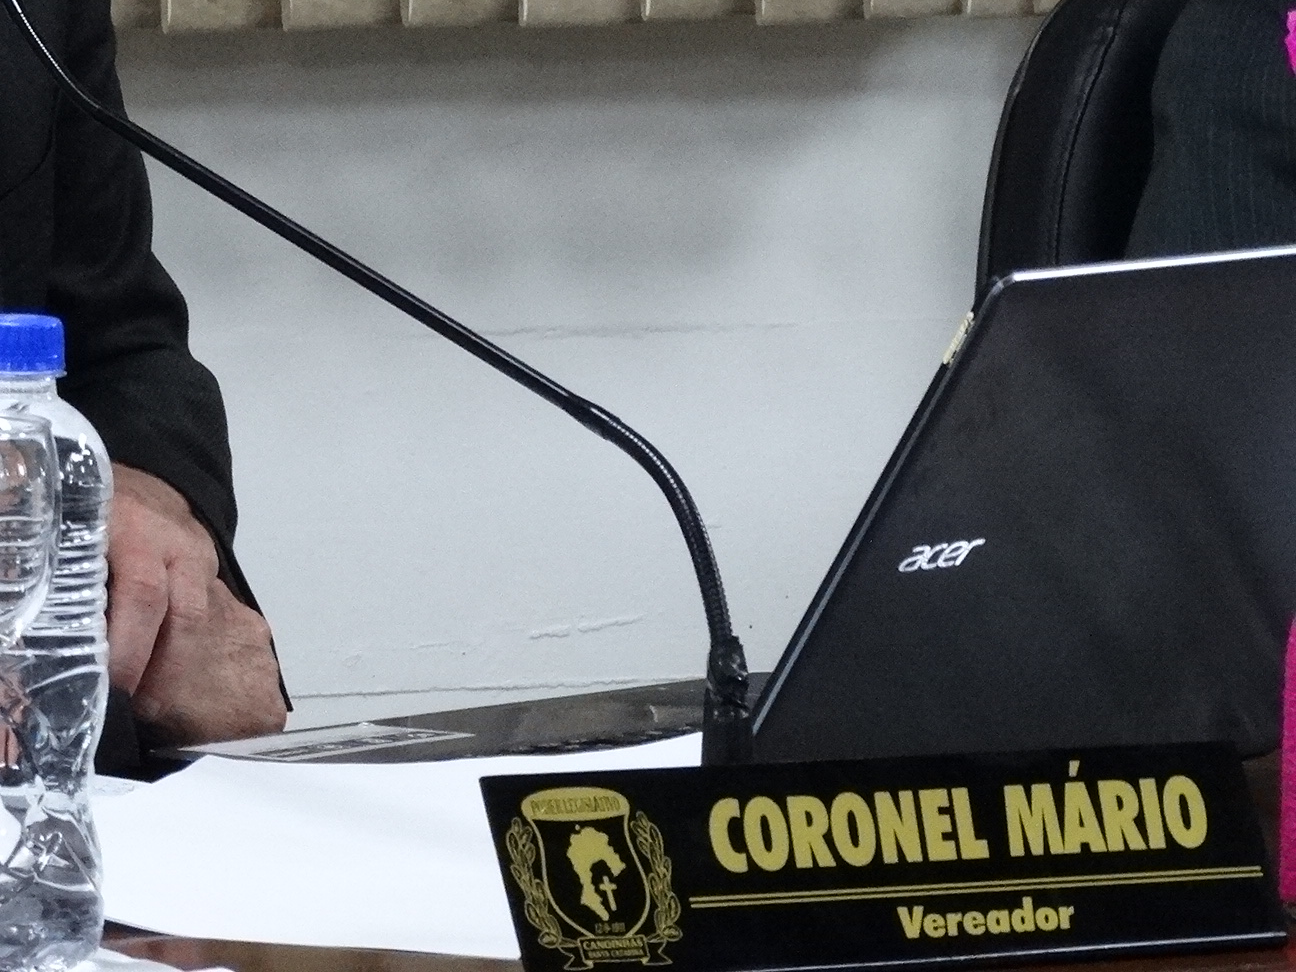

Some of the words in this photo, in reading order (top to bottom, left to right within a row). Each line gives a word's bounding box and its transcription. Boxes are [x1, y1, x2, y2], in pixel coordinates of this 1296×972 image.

[898, 538, 986, 572] acer
[709, 787, 989, 873] CORONEL
[1004, 760, 1207, 857] MÁRIO
[897, 897, 1074, 938] Vereador
